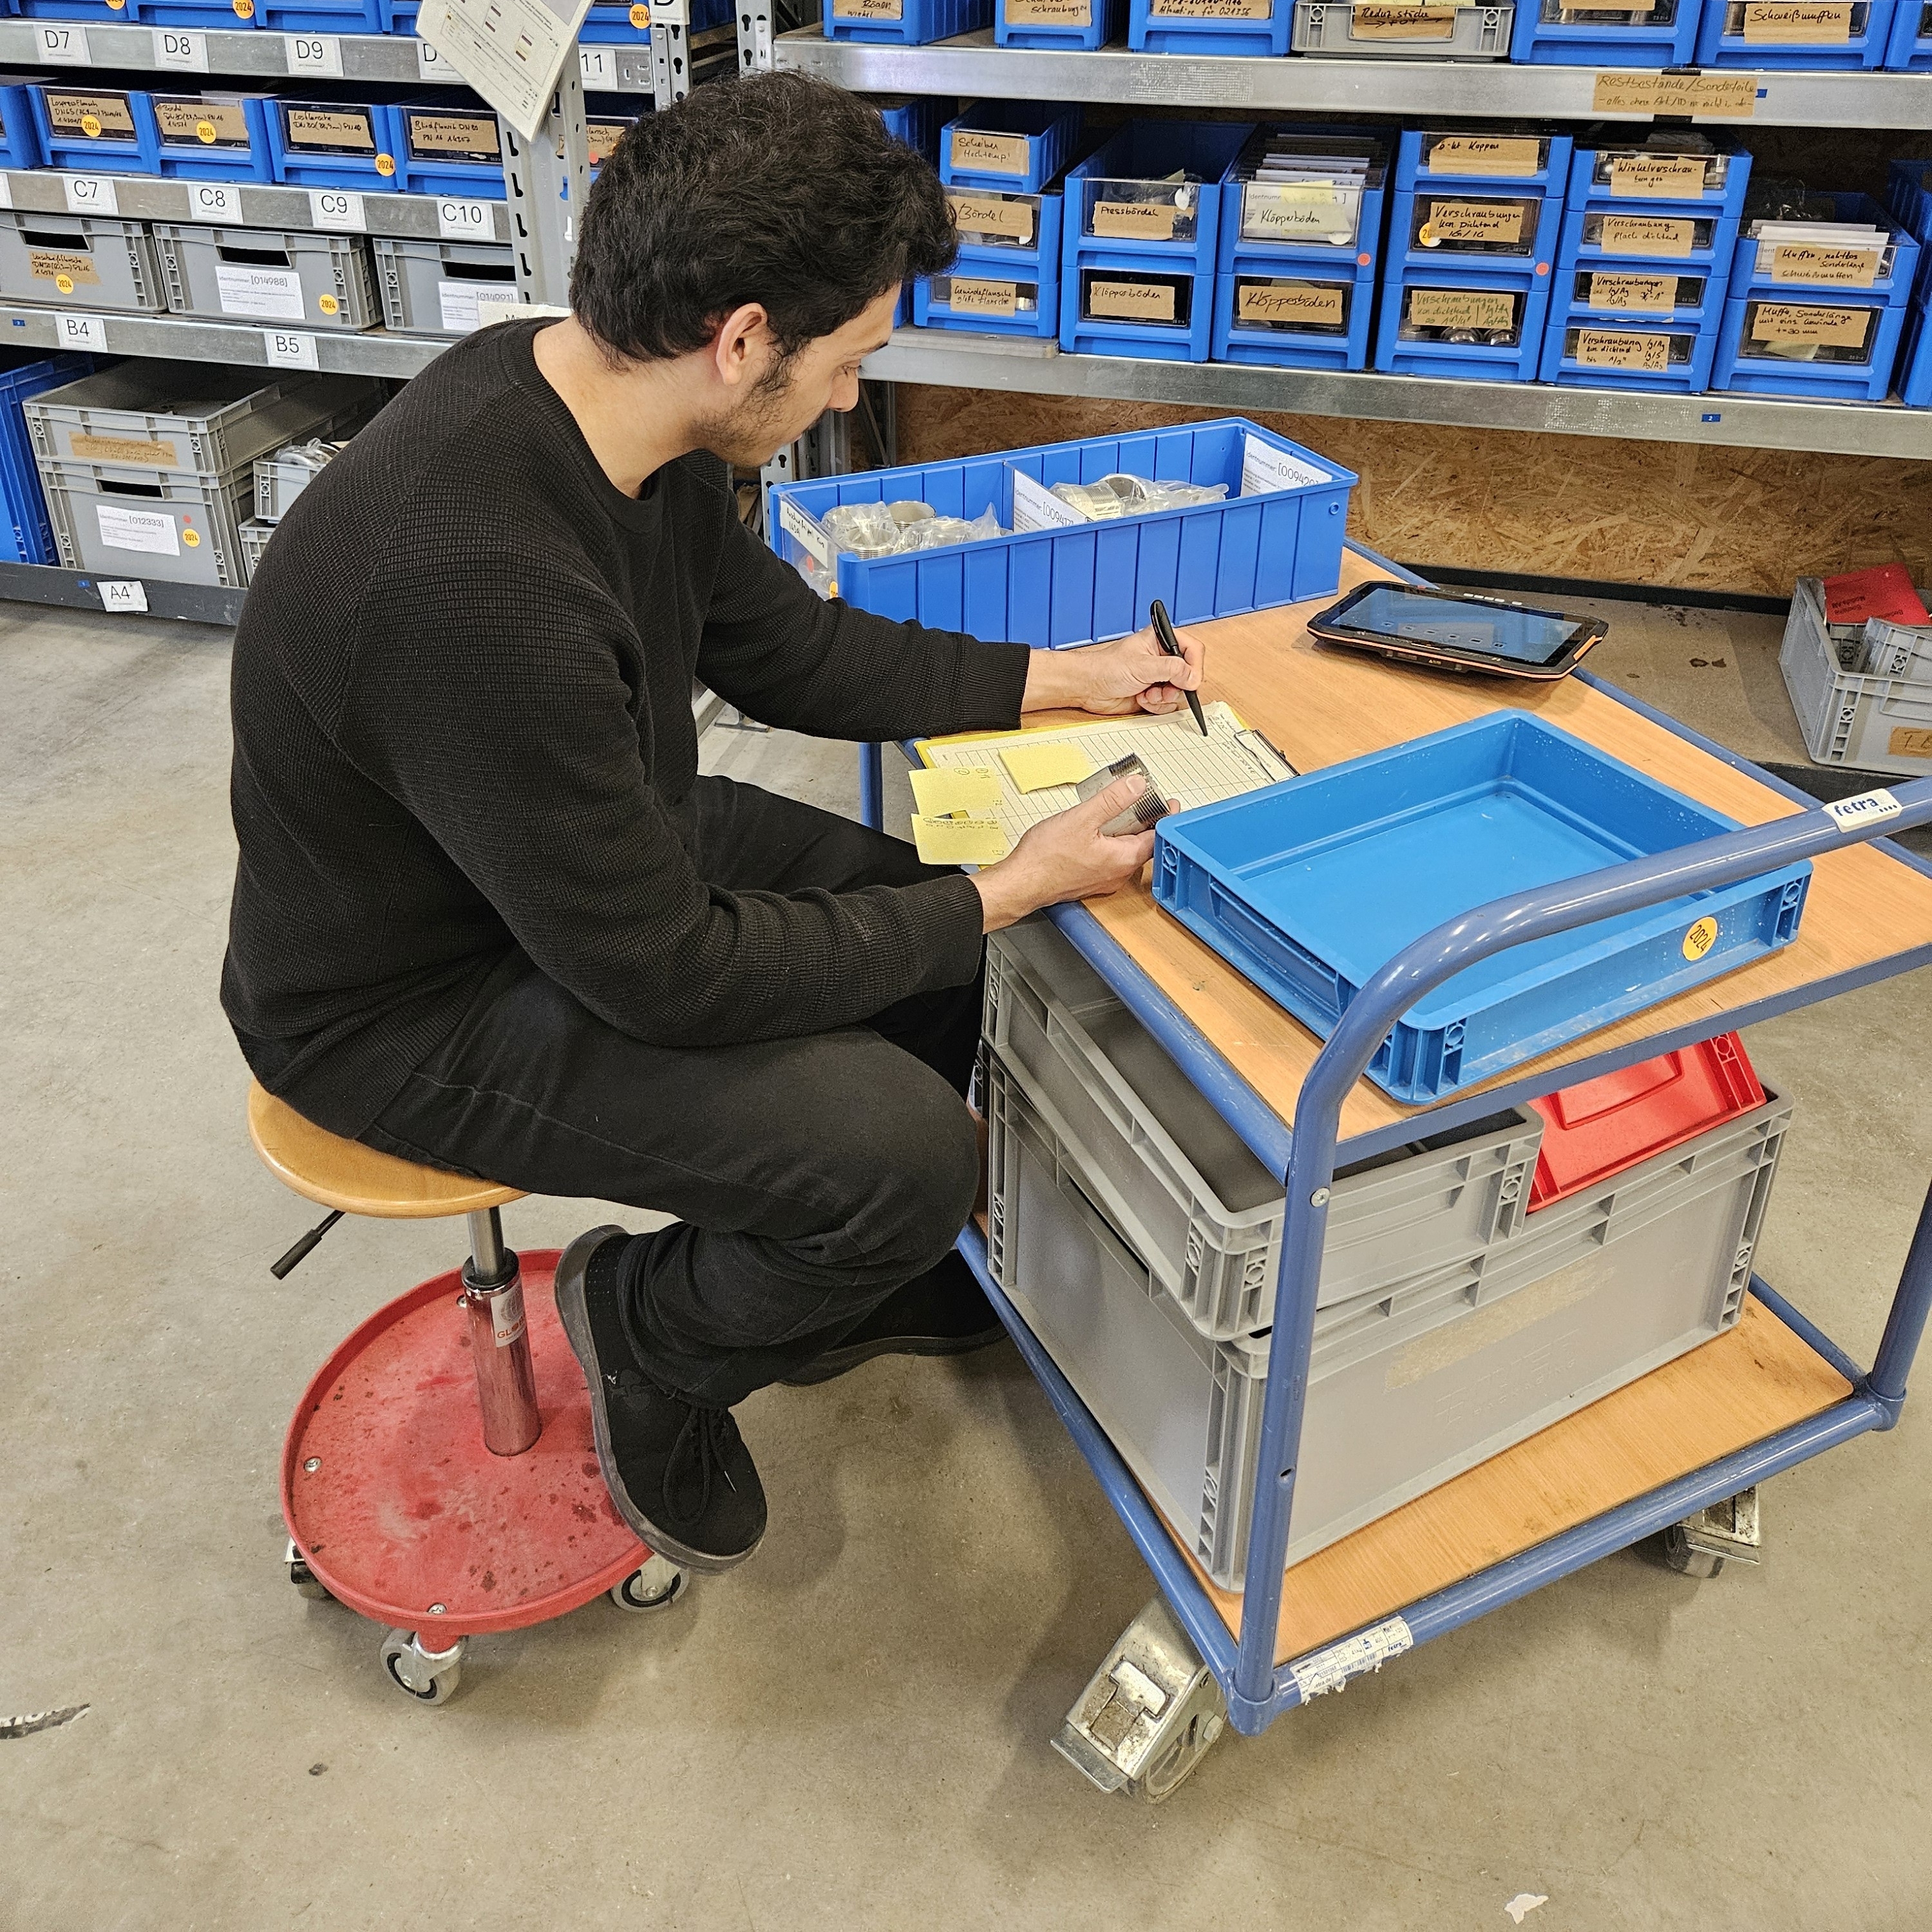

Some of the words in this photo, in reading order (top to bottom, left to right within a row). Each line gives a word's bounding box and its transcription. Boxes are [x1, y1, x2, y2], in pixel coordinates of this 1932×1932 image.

[235, 2, 252, 12] 2024
[632, 11, 649, 21] 2024
[44, 30, 70, 49] D7
[164, 34, 191, 55] D8
[297, 40, 323, 59] D9
[84, 121, 99, 130] 2024
[377, 160, 393, 169] 2024
[74, 180, 98, 198] C7
[200, 188, 226, 207] C8
[321, 194, 348, 214] C9
[442, 203, 482, 223] C10
[251, 275, 288, 287] [014988]
[321, 299, 336, 308] 2024
[68, 319, 90, 337] B4
[276, 336, 299, 354] B5
[129, 515, 164, 528] [012333]
[184, 532, 198, 541] 2024
[111, 585, 130, 600] A4
[1834, 795, 1880, 817] fetra
[1689, 924, 1712, 953] 2024
